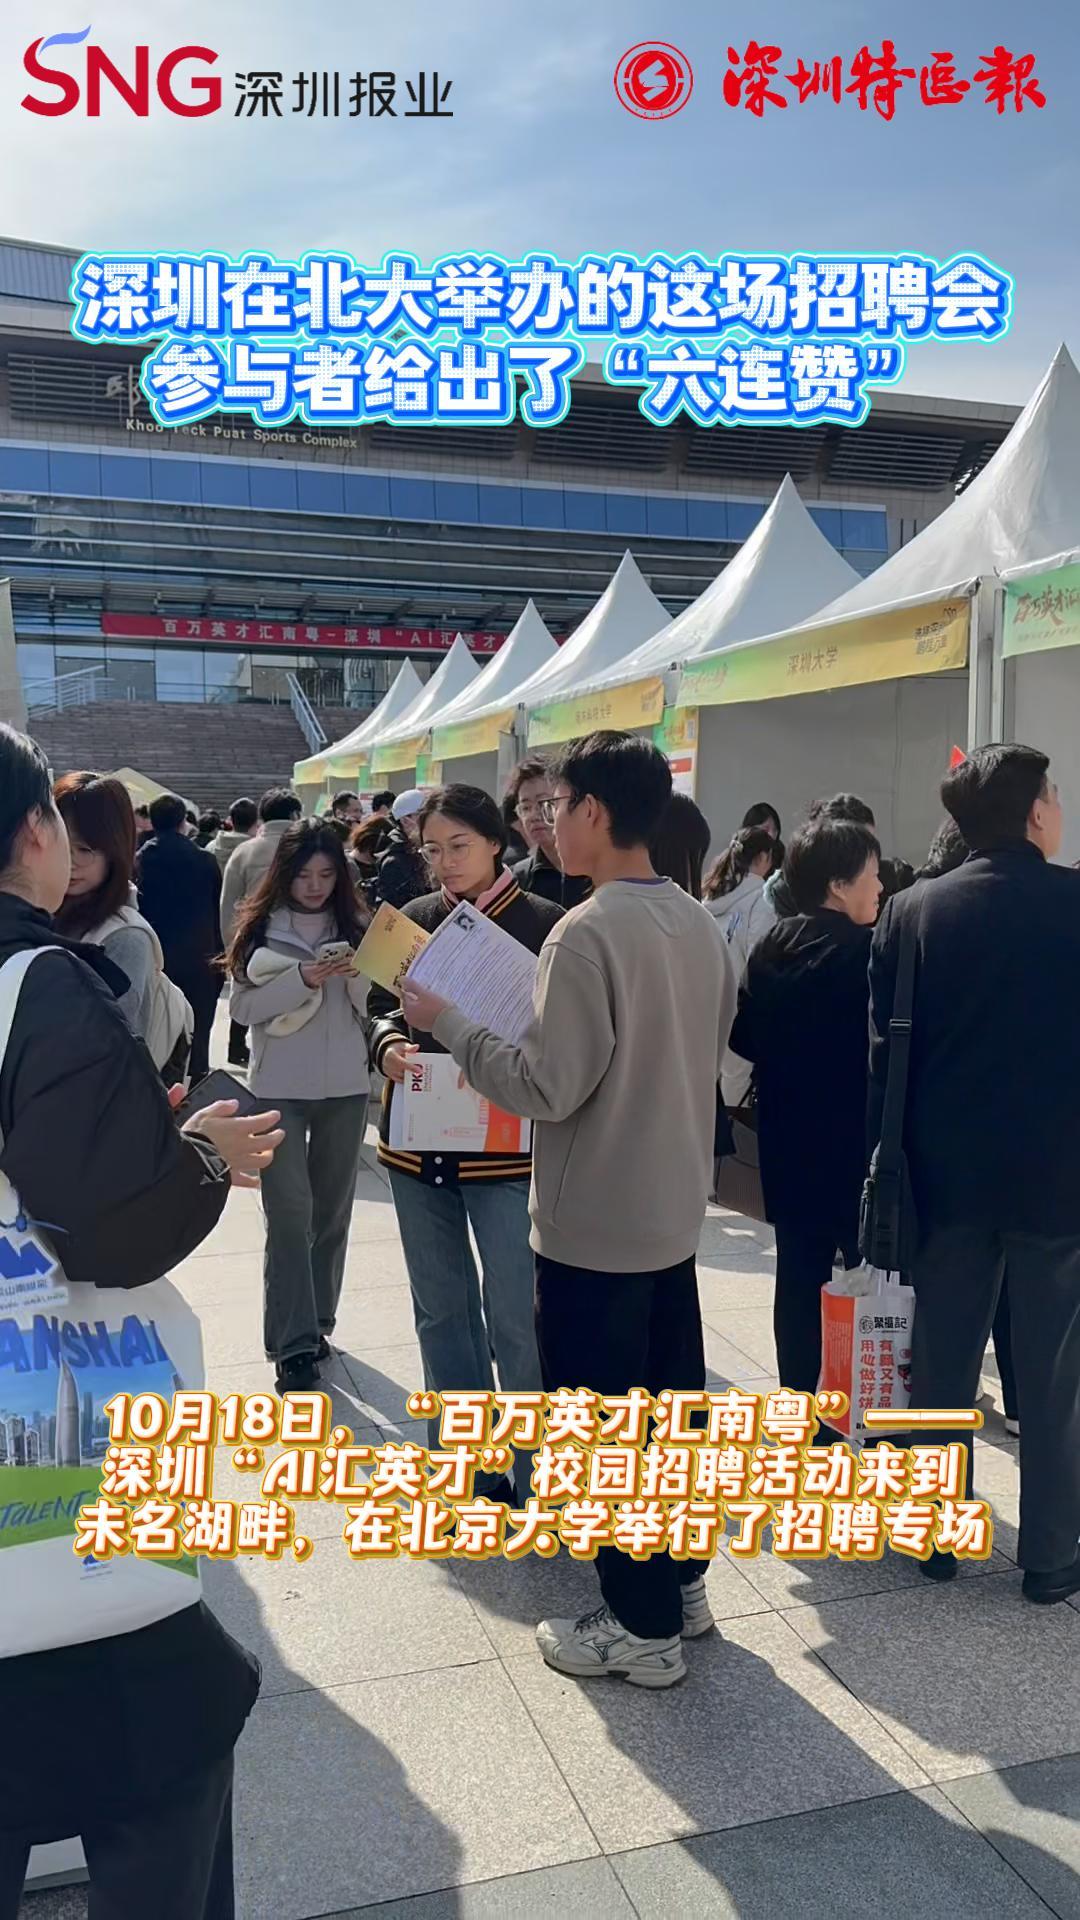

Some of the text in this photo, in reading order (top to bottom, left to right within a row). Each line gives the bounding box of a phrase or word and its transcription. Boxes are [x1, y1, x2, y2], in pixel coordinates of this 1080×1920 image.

[126, 418, 164, 433] Khoo
[213, 425, 246, 440] Puat
[253, 429, 297, 443] Sports
[302, 432, 357, 448] Complex
[787, 646, 839, 677] 深圳大学
